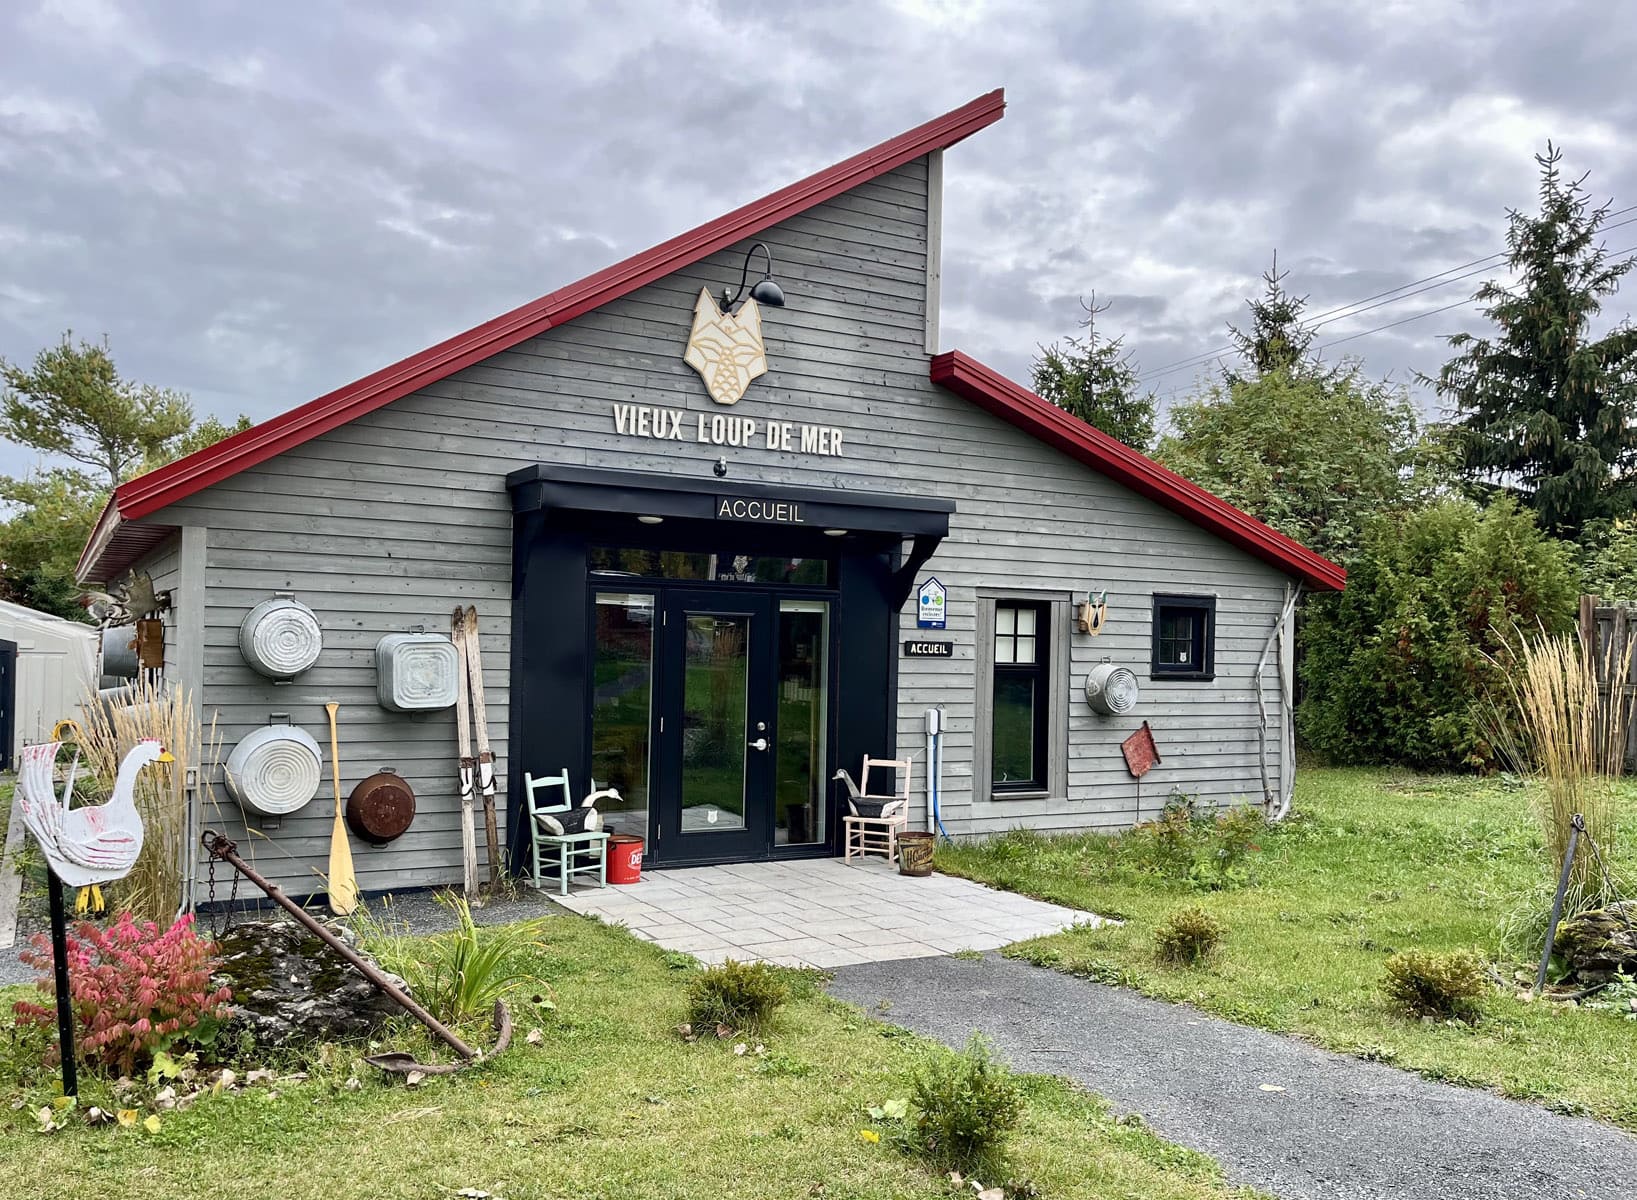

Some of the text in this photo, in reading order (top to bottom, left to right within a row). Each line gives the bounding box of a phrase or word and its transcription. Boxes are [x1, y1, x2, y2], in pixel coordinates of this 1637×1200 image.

[613, 403, 844, 457] VIEUX LOUP DE MER
[718, 499, 804, 522] ACCUEIL
[910, 643, 948, 654] ACCUEIL
